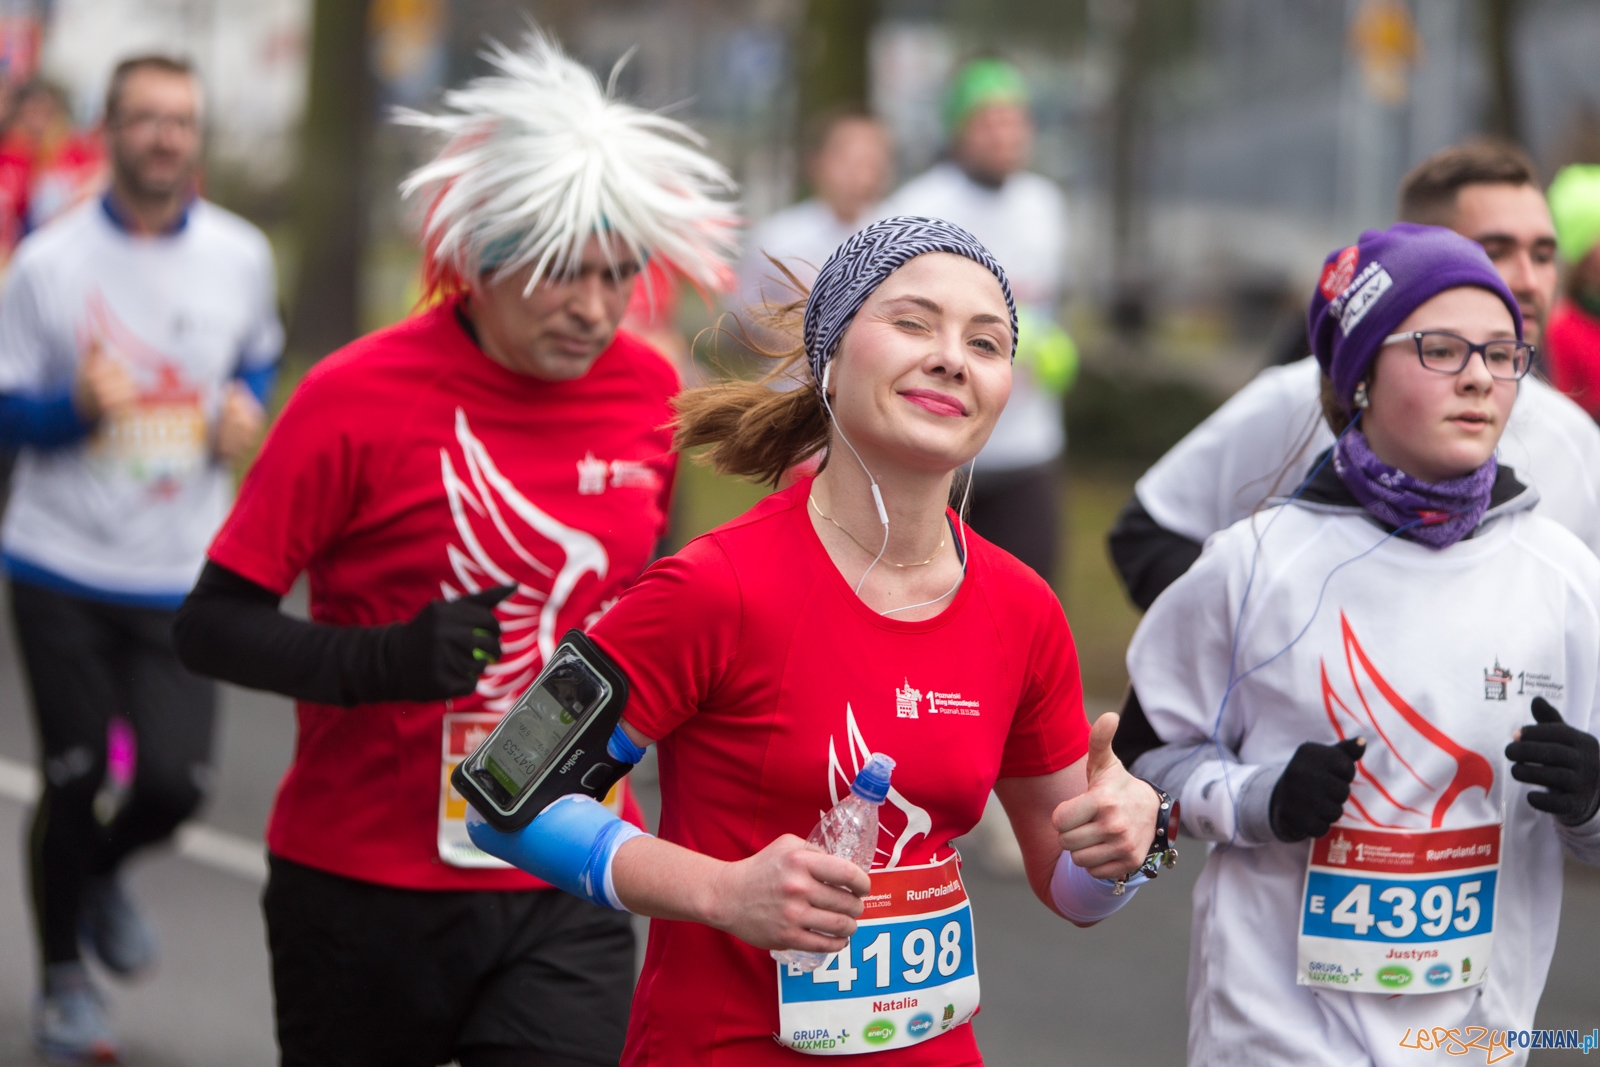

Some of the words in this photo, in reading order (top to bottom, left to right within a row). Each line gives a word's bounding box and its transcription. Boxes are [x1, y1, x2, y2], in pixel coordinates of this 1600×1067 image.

[1517, 671, 1525, 694] 1
[926, 691, 938, 713] 1
[502, 738, 536, 775] 0:47:53
[559, 748, 585, 775] belkin
[1355, 843, 1365, 862] 1
[1426, 844, 1491, 861] RunPoland.org
[1309, 895, 1326, 915] E
[1331, 880, 1482, 938] 4395
[812, 920, 962, 993] 4198
[1385, 948, 1439, 962] Justyna
[1308, 961, 1344, 974] GRUPA
[1308, 972, 1349, 984] LUXMED
[872, 997, 918, 1013] Natalia
[793, 1029, 829, 1041] GRUPA
[867, 1028, 893, 1039] energy
[791, 1038, 836, 1049] LUXMED
